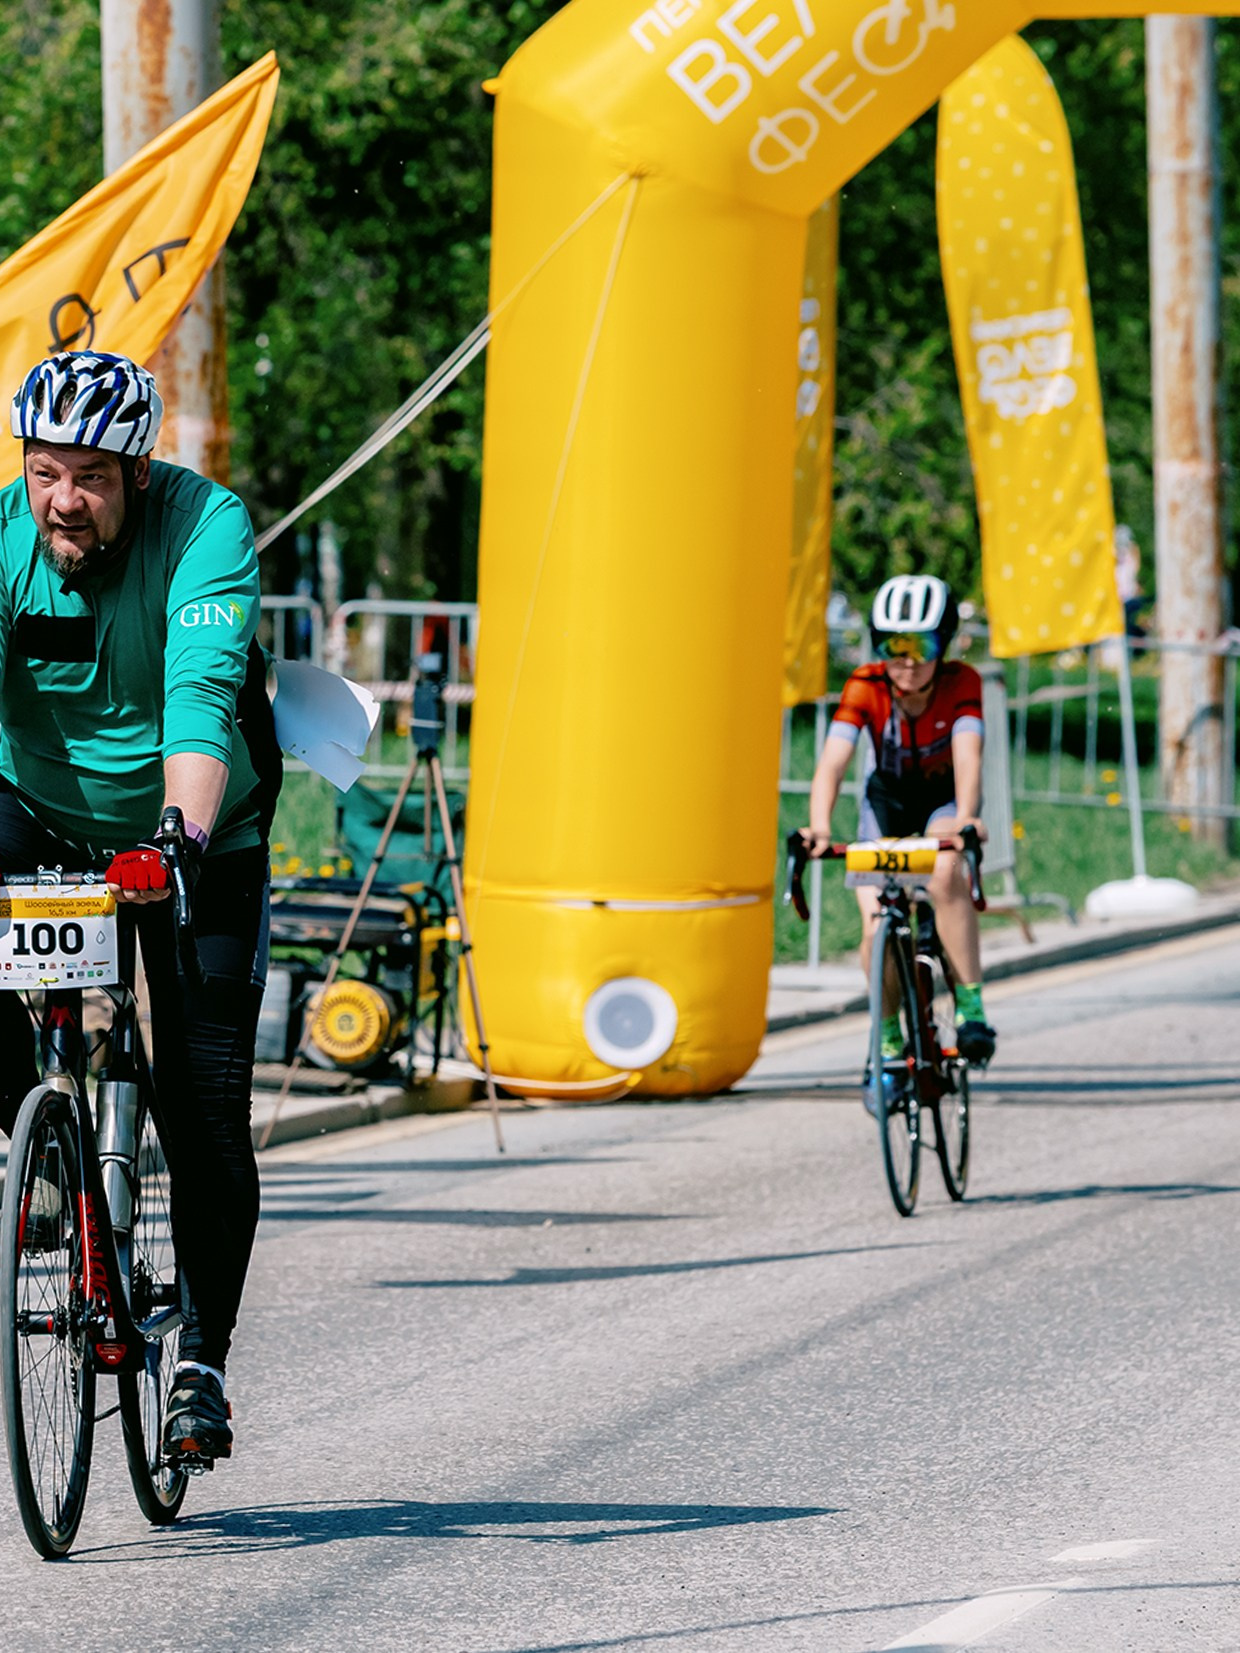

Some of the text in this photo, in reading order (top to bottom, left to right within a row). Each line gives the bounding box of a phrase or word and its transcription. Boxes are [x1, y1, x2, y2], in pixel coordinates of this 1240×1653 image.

[180, 603, 234, 628] GIN
[874, 852, 911, 872] 181
[13, 922, 84, 956] 100
